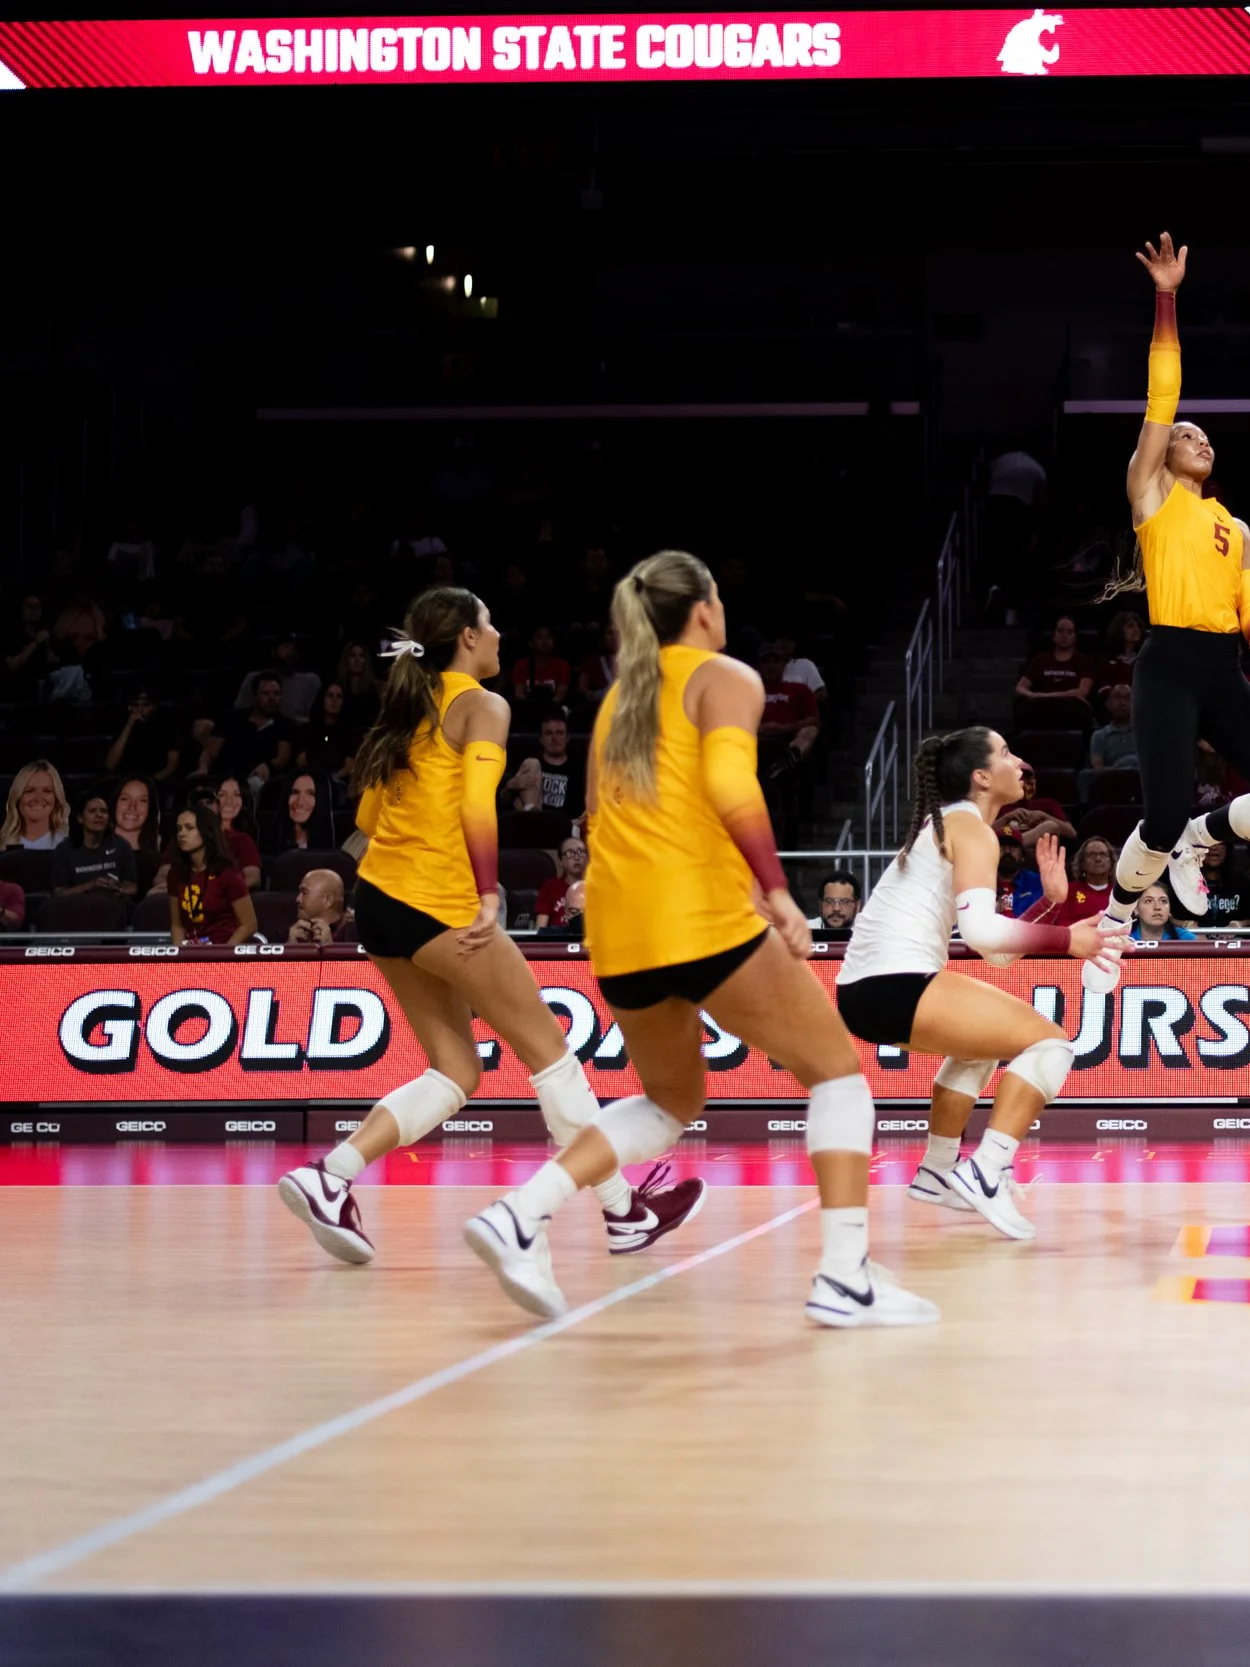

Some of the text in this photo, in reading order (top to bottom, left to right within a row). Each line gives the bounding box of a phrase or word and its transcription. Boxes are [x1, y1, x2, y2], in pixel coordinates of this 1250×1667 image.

[188, 22, 843, 75] WASHINGTON STATE COUGARS
[1214, 522, 1230, 557] 5
[25, 946, 75, 956] GEICO
[129, 945, 179, 956] GEICO
[234, 945, 284, 955] GECO
[58, 985, 392, 1074] GOLD
[10, 1122, 60, 1133] GECO
[116, 1121, 166, 1131] GEICO
[225, 1120, 276, 1131] GEICO
[335, 1120, 362, 1131] GEI
[442, 1120, 493, 1131] GEICO
[767, 1120, 807, 1131] GEIC
[877, 1120, 929, 1131] GEICO
[1096, 1119, 1147, 1130] GEICO
